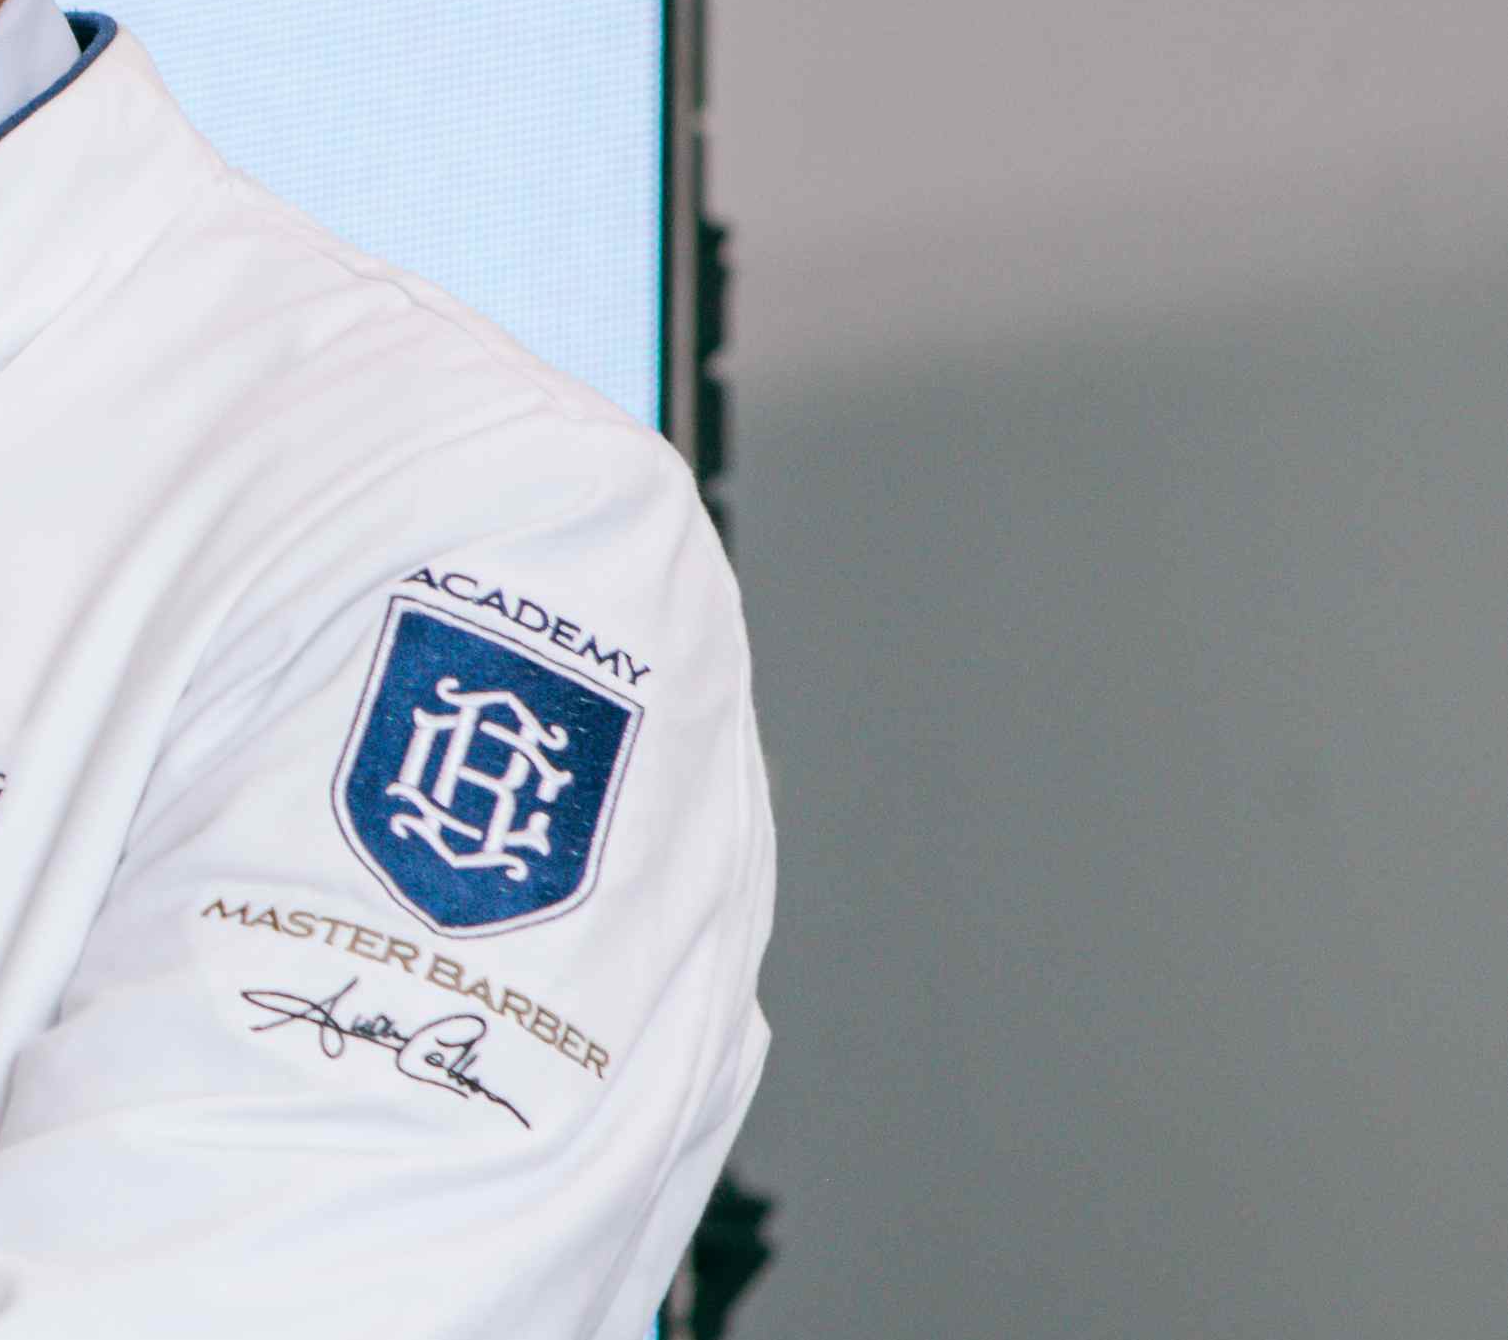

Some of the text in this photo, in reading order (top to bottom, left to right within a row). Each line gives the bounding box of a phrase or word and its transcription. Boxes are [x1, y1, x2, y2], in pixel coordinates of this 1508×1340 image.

[403, 567, 651, 686] ACADEMY
[201, 898, 420, 976] MASTER
[426, 953, 611, 1080] BARBER
